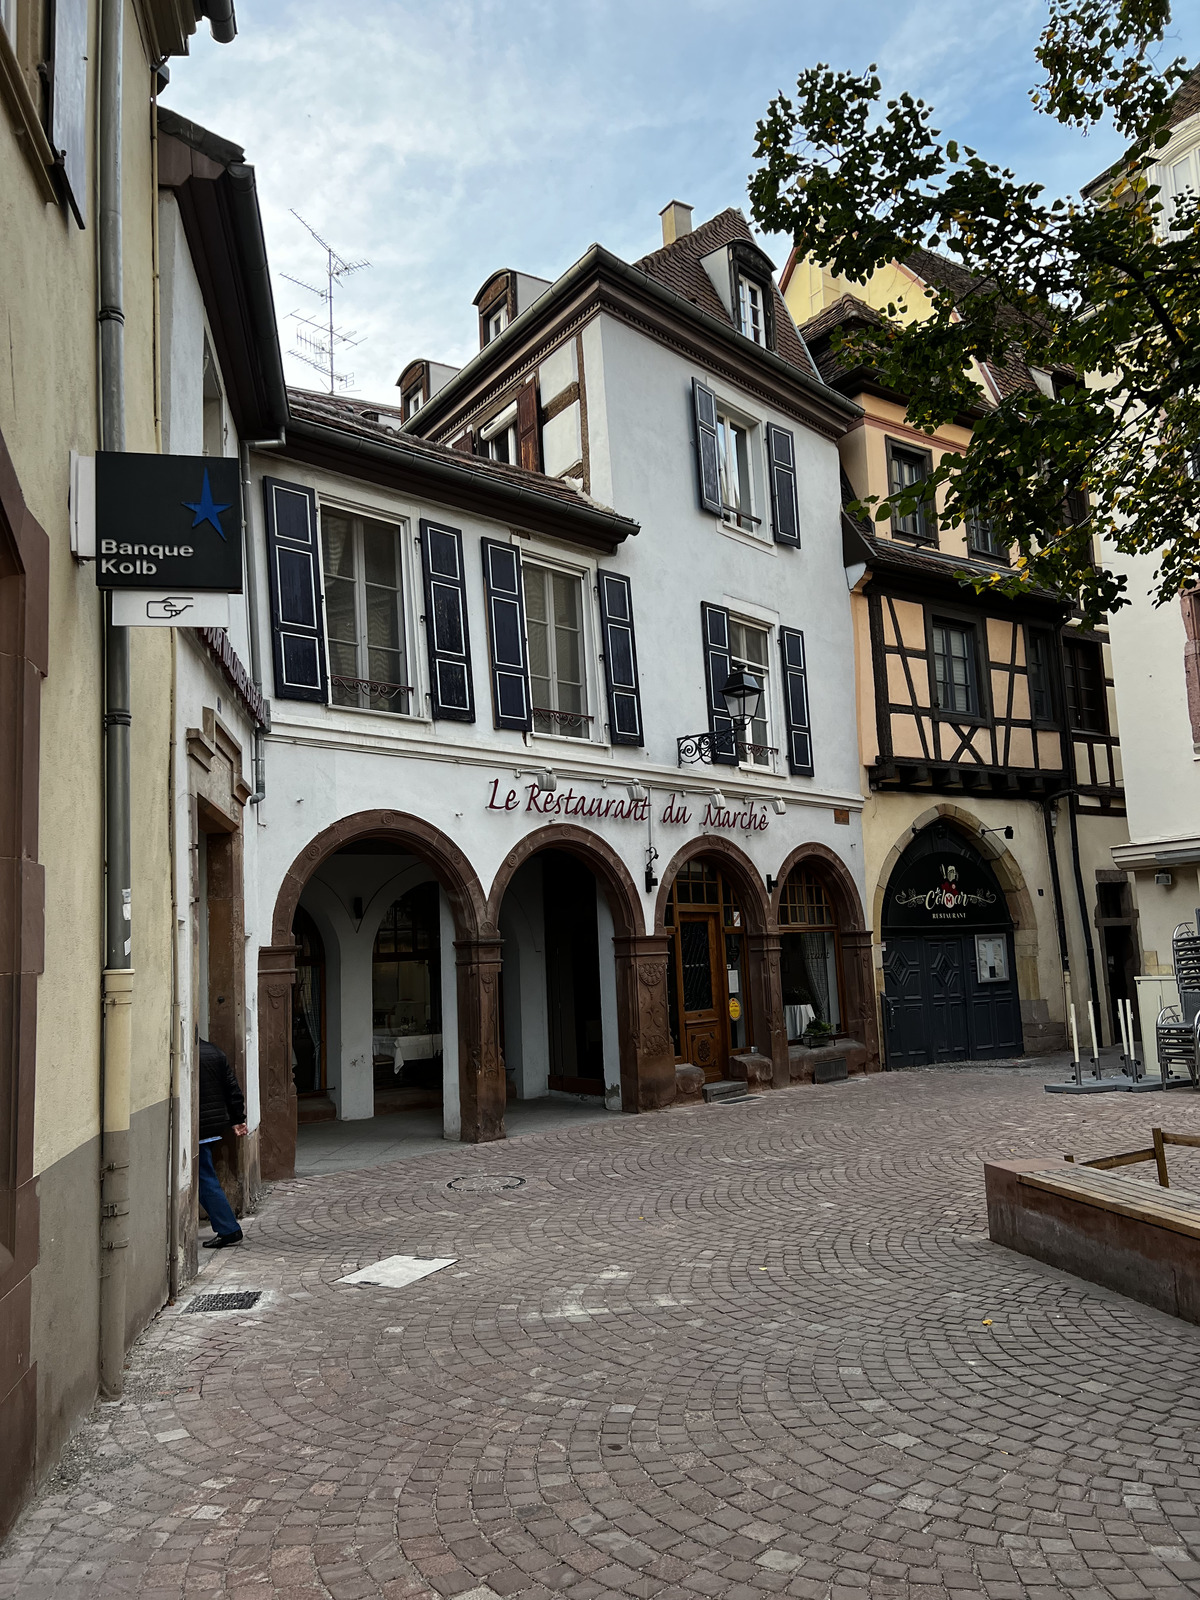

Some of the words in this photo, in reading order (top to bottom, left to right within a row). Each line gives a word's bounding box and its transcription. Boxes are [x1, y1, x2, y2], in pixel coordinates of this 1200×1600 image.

[101, 538, 194, 560] Banque
[101, 558, 157, 575] Kolb
[486, 778, 520, 810] Le
[525, 783, 651, 822] Restaurant
[662, 793, 692, 825] du
